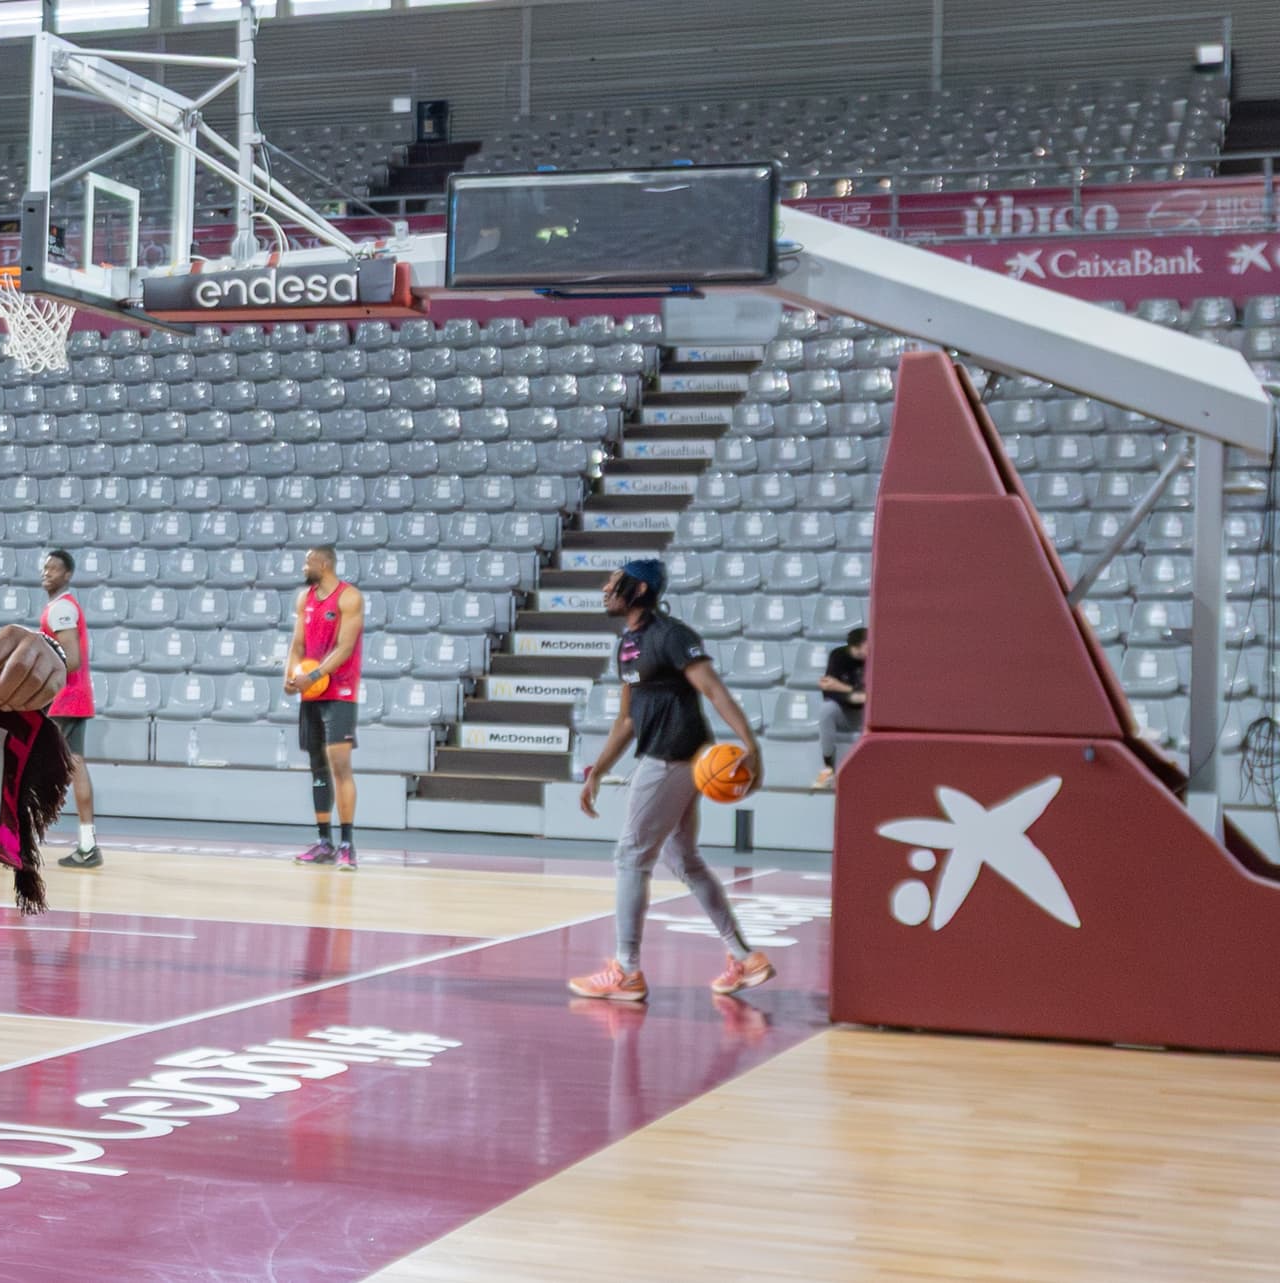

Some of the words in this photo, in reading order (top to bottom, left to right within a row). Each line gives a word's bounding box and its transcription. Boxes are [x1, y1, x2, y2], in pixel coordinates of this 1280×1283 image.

[1050, 246, 1203, 279] CaixaBank
[196, 269, 357, 308] endesa
[631, 479, 690, 493] CaixaBank
[611, 515, 671, 530] CaixaBank
[541, 639, 611, 651] McDonald's
[515, 684, 587, 696] McDonald's
[489, 733, 563, 746] McDonald's
